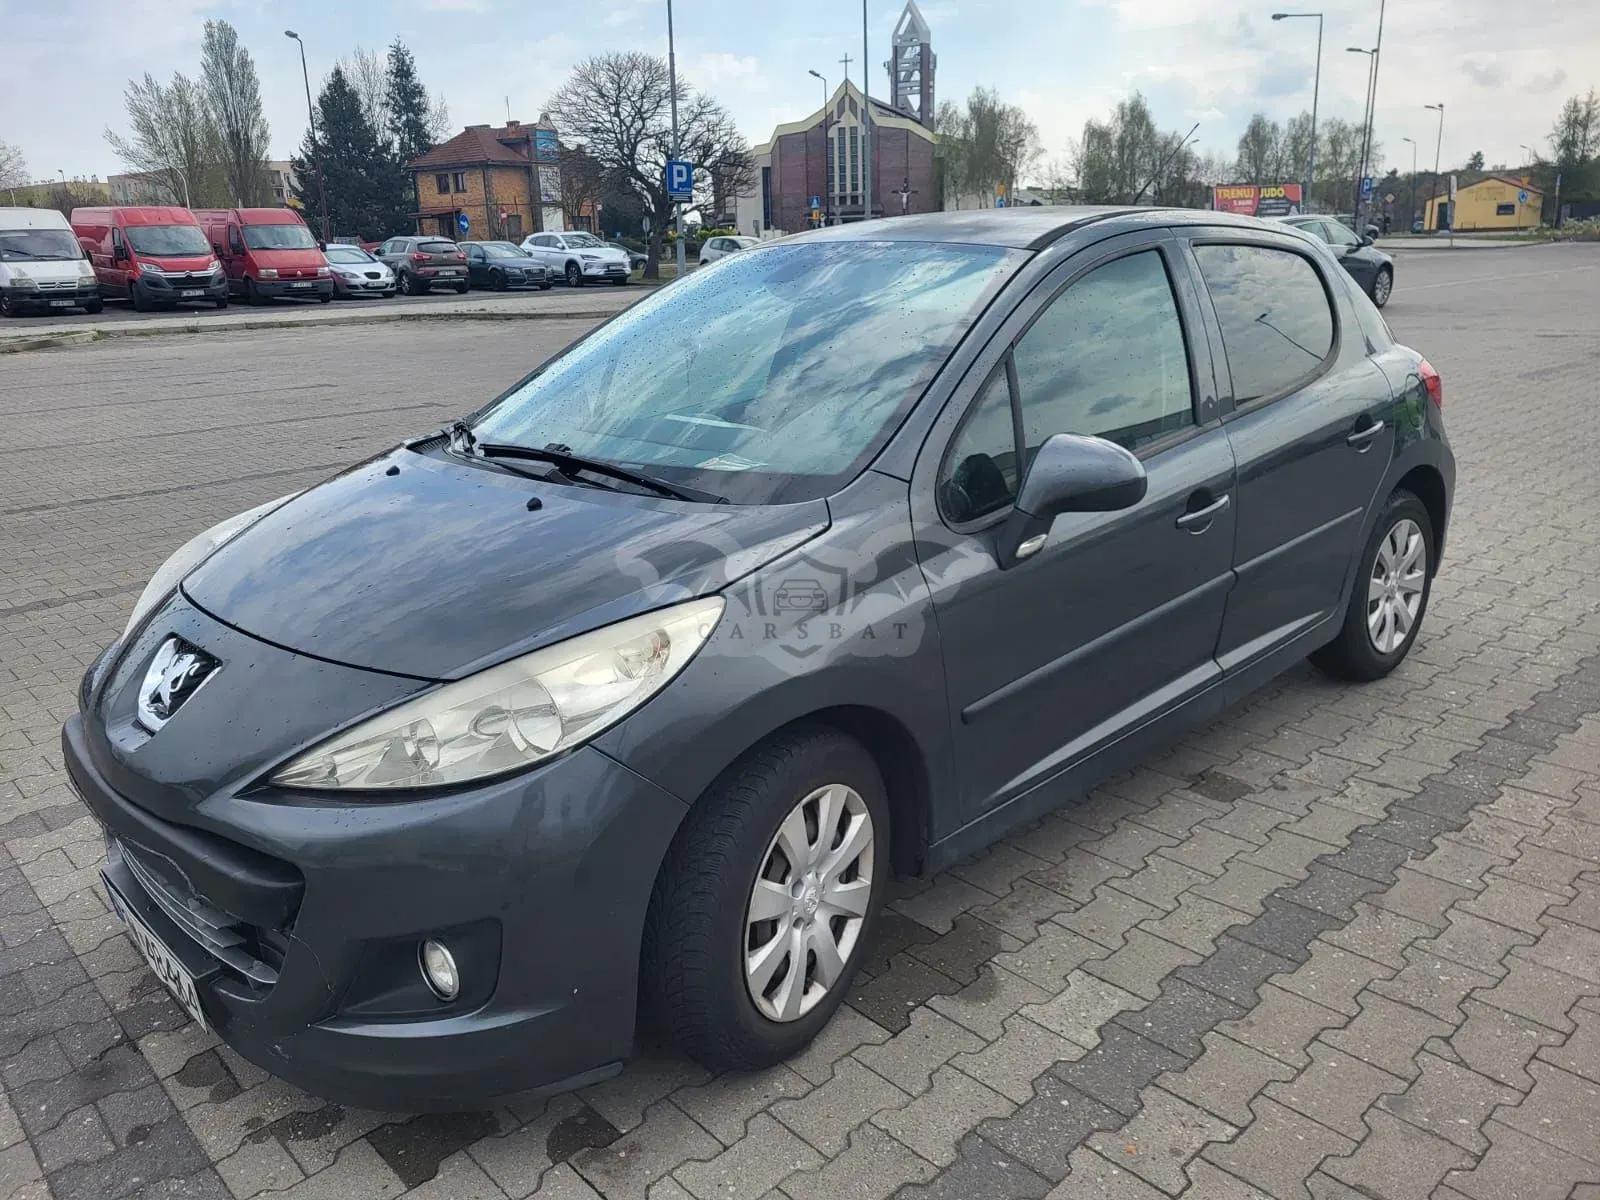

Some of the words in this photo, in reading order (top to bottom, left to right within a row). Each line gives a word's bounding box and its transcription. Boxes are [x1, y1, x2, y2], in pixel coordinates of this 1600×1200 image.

[672, 165, 688, 189] P
[1363, 179, 1370, 192] P
[1217, 187, 1254, 199] TRENUJ
[1259, 186, 1285, 198] JUDO
